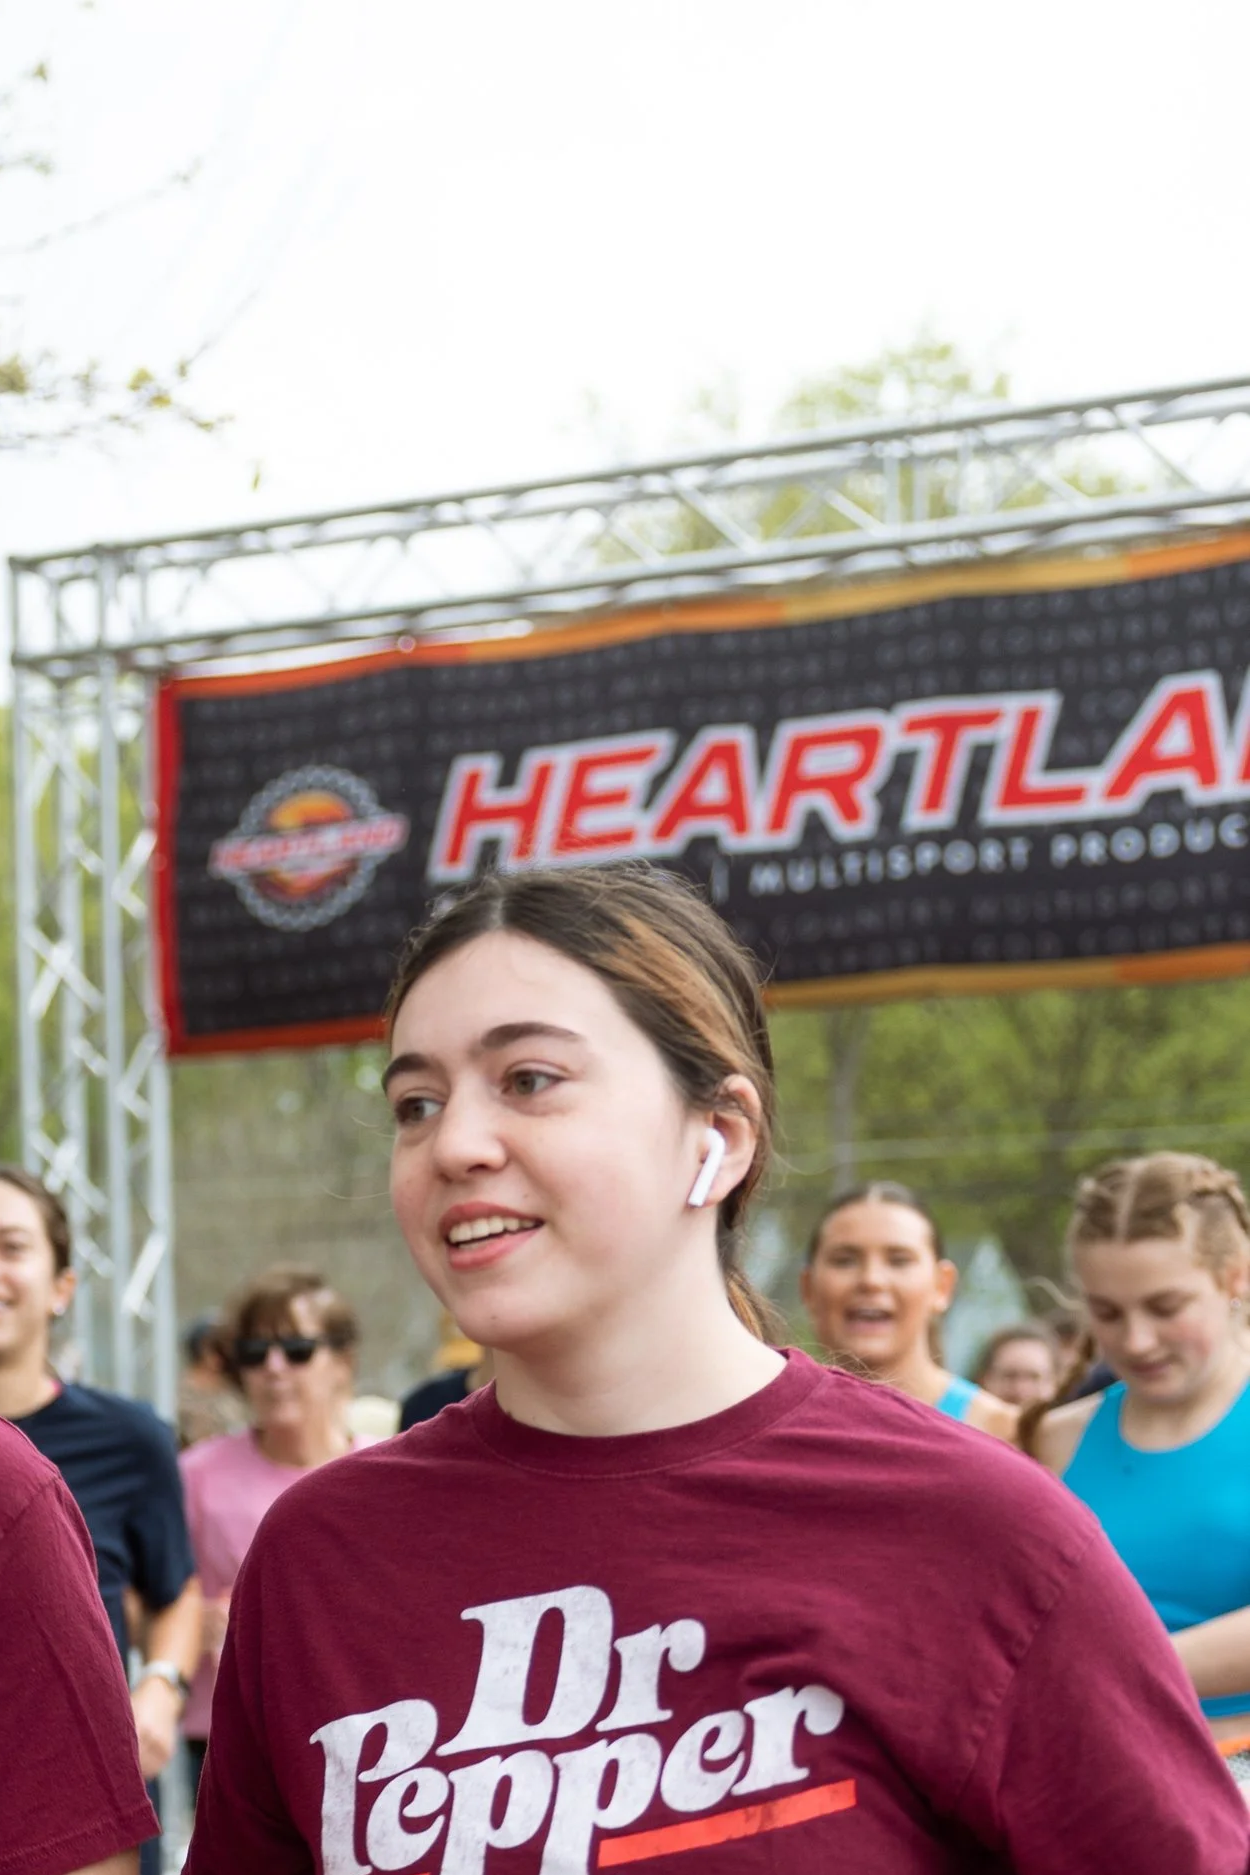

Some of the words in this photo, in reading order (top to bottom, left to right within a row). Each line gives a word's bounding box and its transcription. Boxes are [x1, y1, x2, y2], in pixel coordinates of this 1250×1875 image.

[427, 668, 1250, 882] HEARTLA
[750, 837, 1031, 896] MULTISPORT
[1050, 812, 1249, 869] PRODUC
[436, 1585, 707, 1757] Dr
